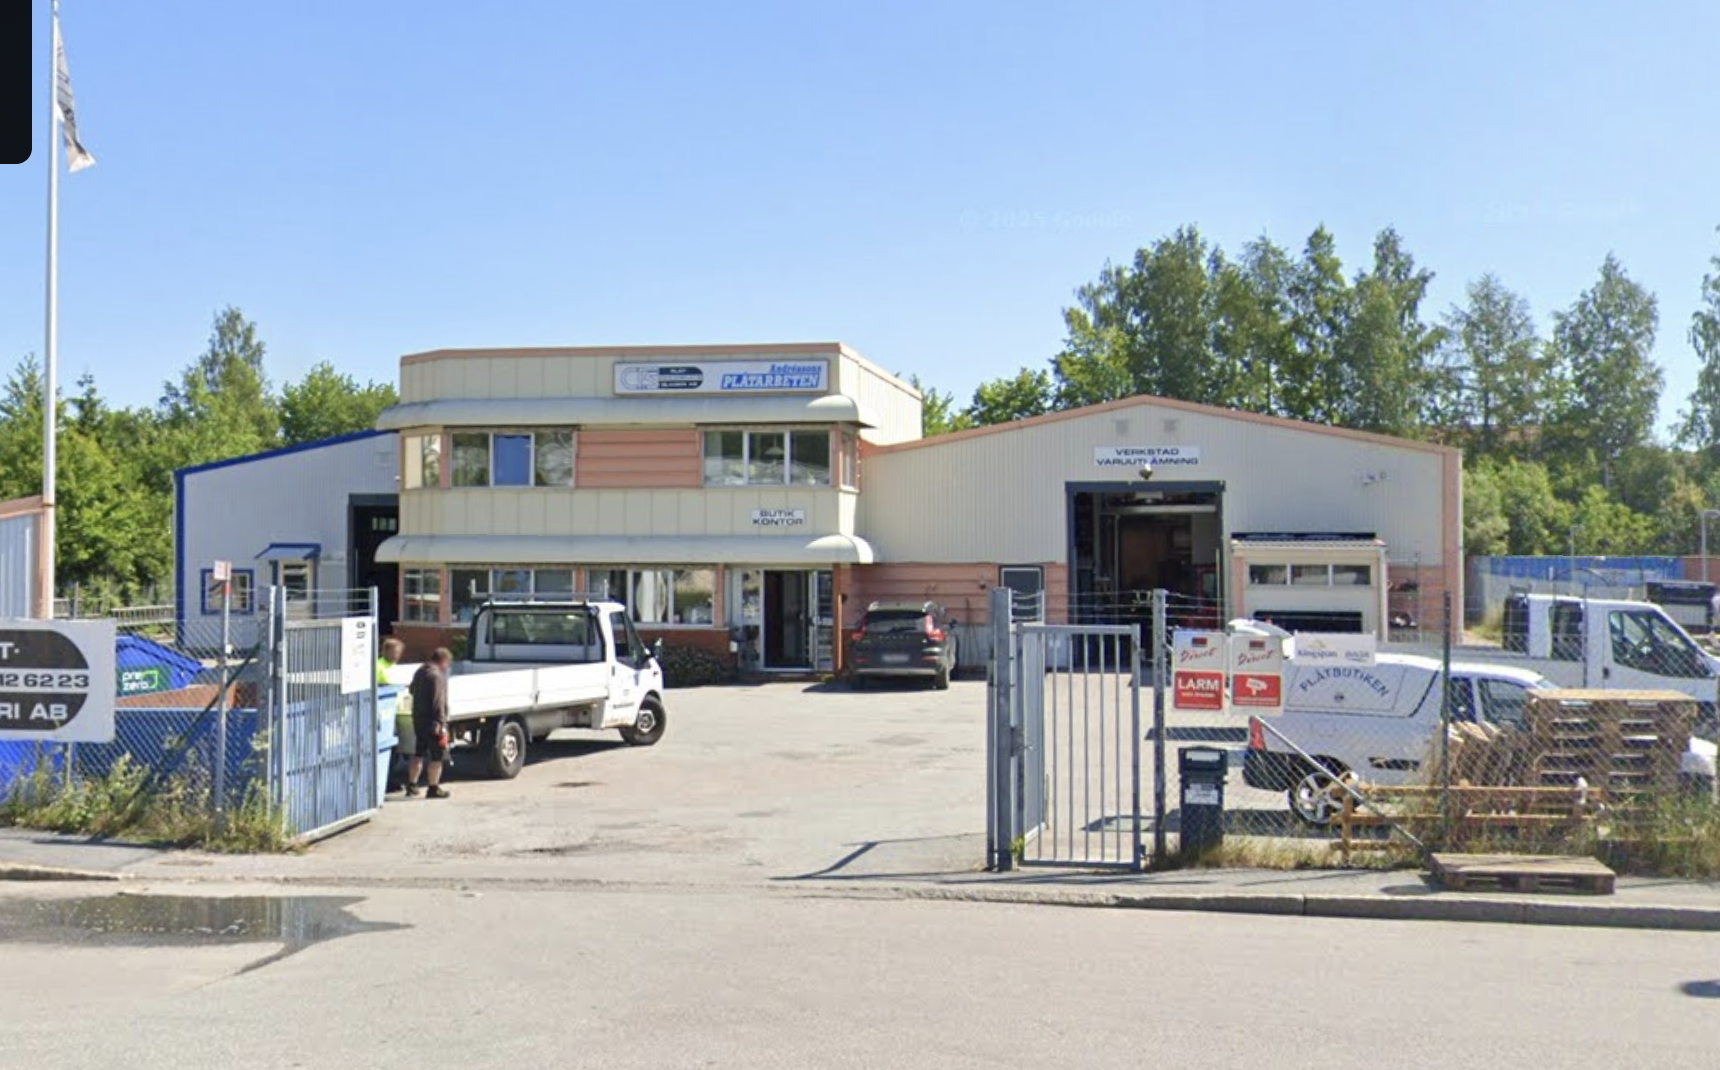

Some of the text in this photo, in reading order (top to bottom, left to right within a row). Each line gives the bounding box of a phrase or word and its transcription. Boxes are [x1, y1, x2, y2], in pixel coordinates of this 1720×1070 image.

[1115, 448, 1179, 456] VERKSTAD
[1177, 678, 1219, 690] LARM
[29, 703, 67, 719] AB
